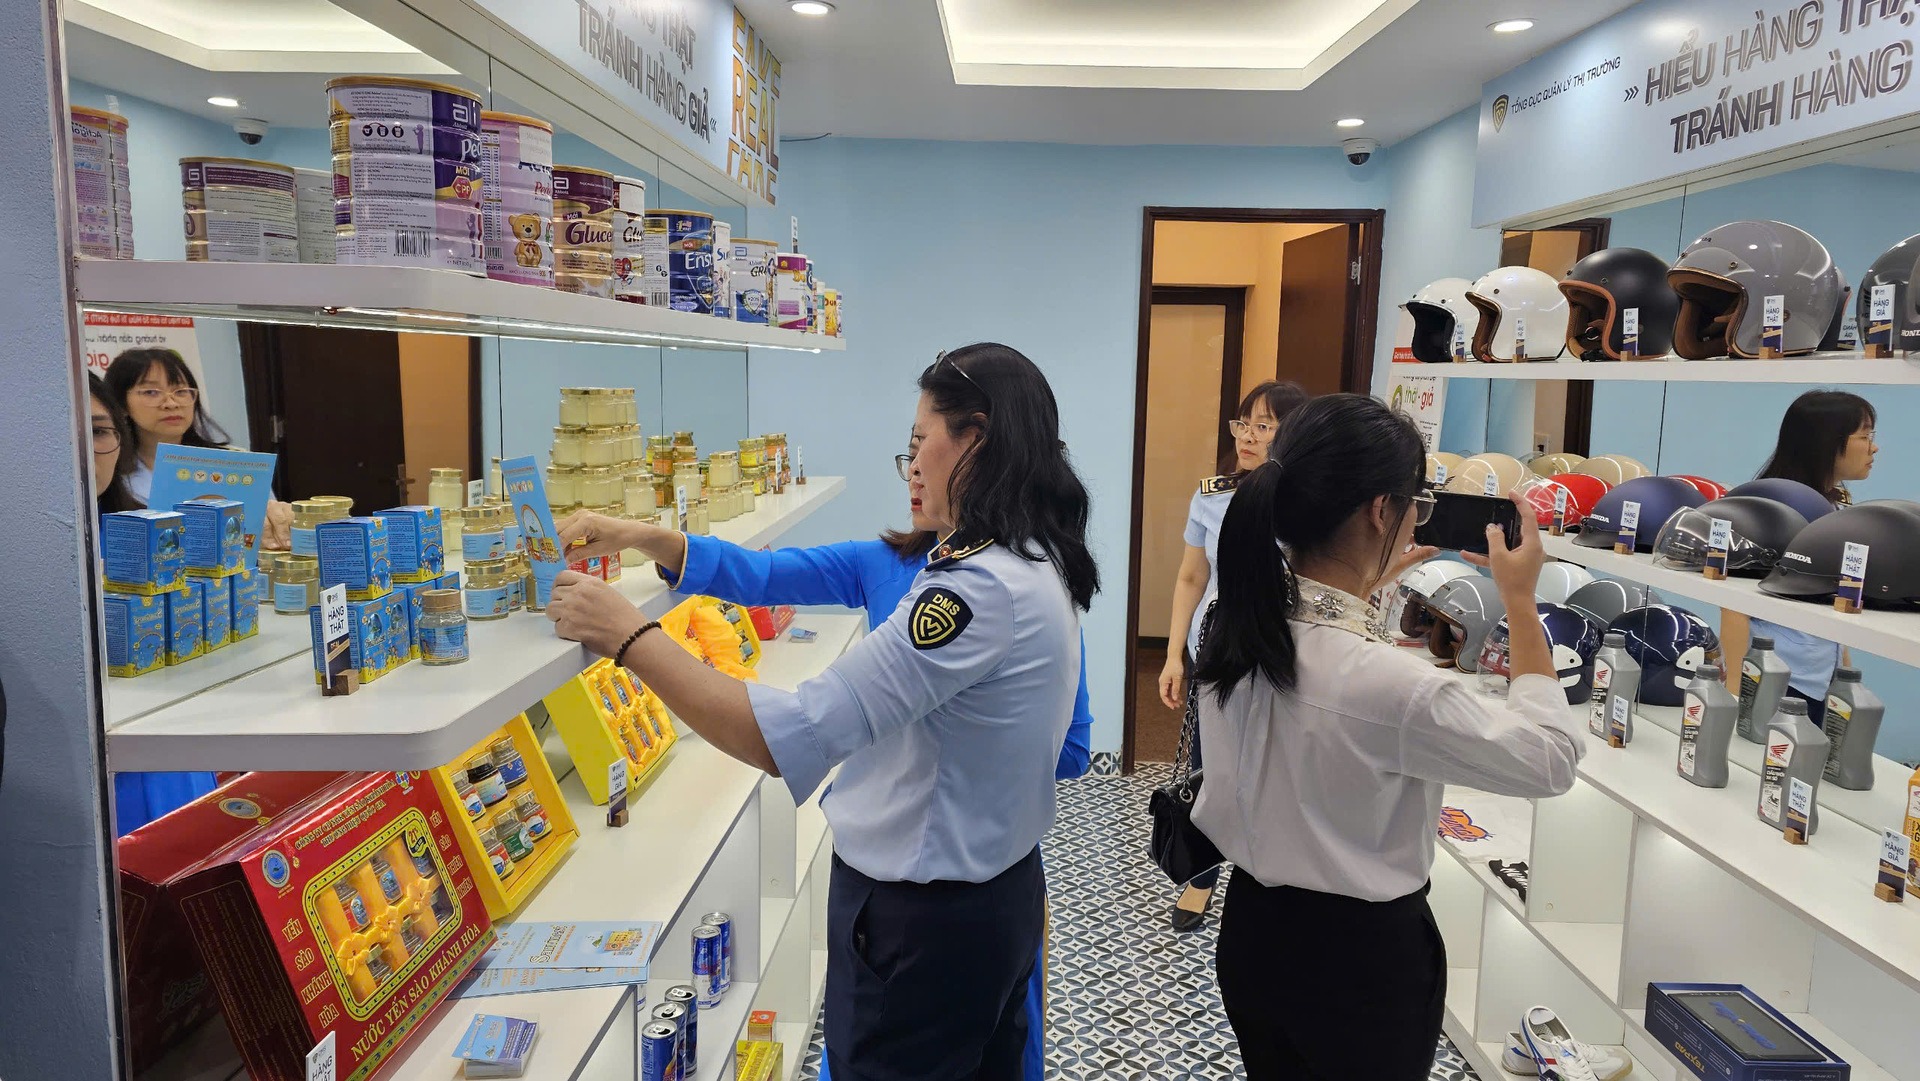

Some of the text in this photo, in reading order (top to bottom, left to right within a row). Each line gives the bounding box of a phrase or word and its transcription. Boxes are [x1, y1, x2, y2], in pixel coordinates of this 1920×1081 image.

[1645, 29, 1713, 105] HIỂU
[1723, 0, 1822, 75] HÀNG
[577, 0, 643, 94] TRÁNH
[646, 52, 686, 125] HÀNG
[688, 87, 710, 144] GIẢ
[1670, 40, 1913, 154] TRÁNH HÀNG
[455, 183, 471, 197] CPP
[1765, 303, 1780, 315] HÀNG
[1712, 528, 1726, 539] HÀNG
[1784, 551, 1812, 564] HONDA
[1845, 553, 1863, 565] HÀNG
[1845, 562, 1860, 575] THẬT
[327, 605, 344, 621] HÀNG
[932, 593, 960, 616] DMS
[329, 618, 344, 635] THẬT
[1885, 841, 1904, 856] HÀNG
[1888, 850, 1900, 863] GIẢ
[282, 917, 304, 942] YẾN
[295, 947, 315, 972] SÀO
[300, 970, 333, 1005] KHÁNH
[351, 923, 481, 1062] NƯỚC YẾN SÀO KHÁNH HÒA
[318, 1003, 340, 1028] HÒA
[312, 1055, 333, 1080] HÀNG
